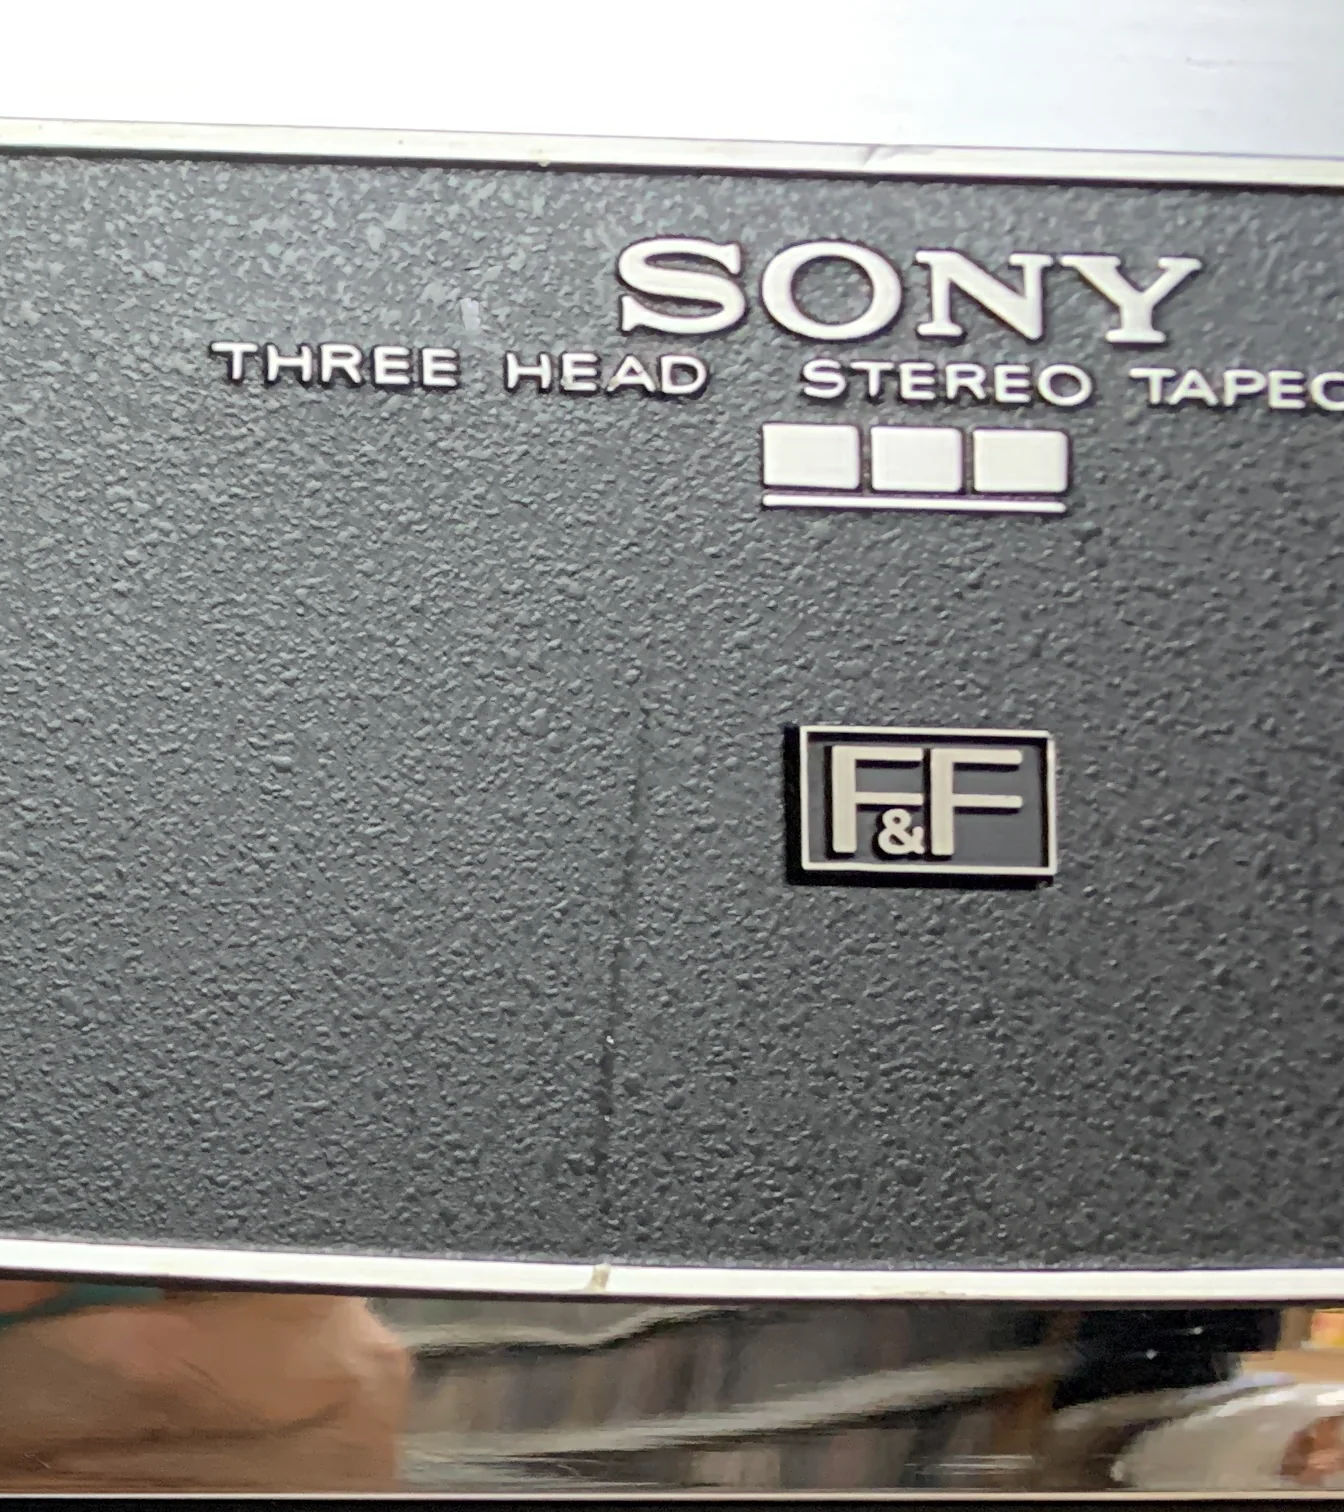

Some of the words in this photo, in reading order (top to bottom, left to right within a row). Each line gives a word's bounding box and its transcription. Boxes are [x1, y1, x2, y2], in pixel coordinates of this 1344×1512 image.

[616, 235, 1203, 345] SONY
[211, 341, 459, 388] THREE
[506, 351, 709, 396] HEAD
[802, 358, 1092, 406] STEREO
[1127, 366, 1344, 412] TAPEC
